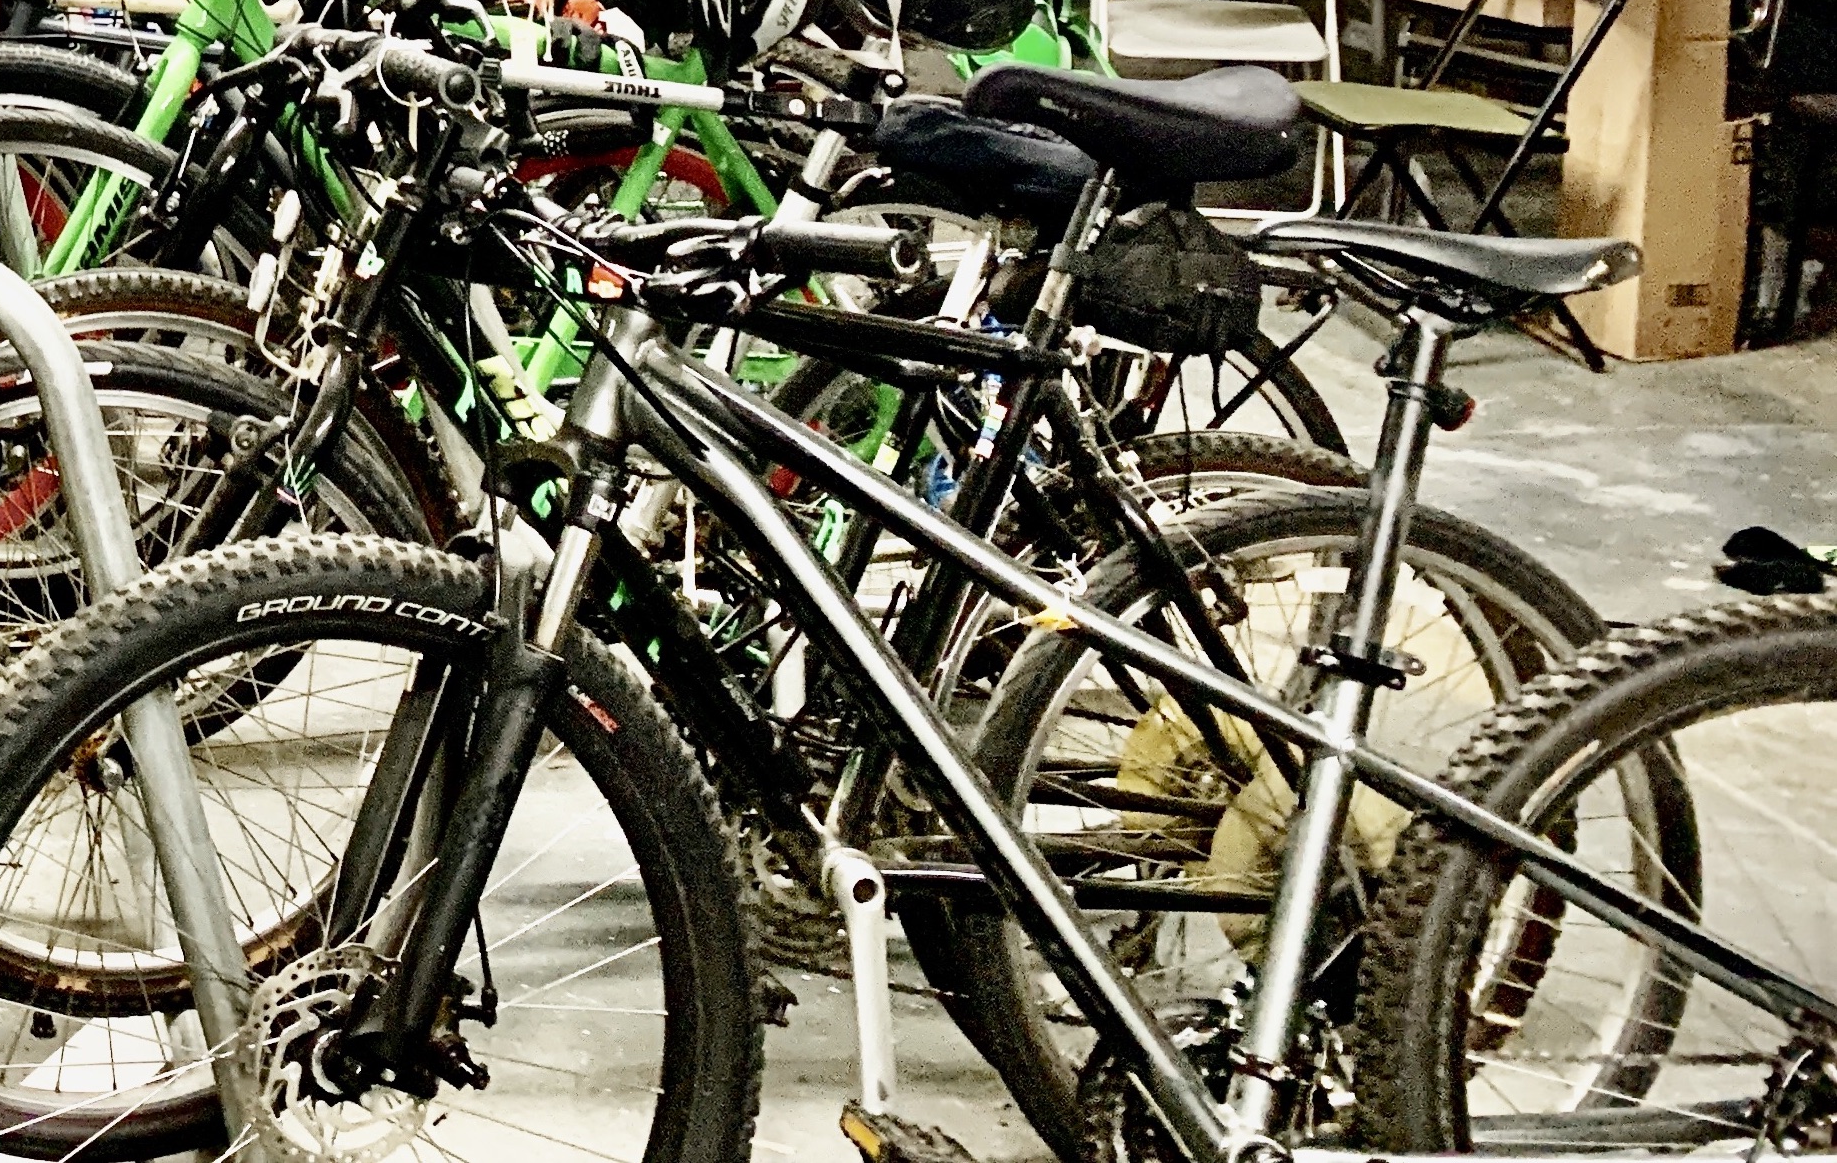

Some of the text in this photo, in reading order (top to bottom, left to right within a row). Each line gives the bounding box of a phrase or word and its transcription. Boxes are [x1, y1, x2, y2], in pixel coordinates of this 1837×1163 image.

[603, 80, 662, 99] THULE
[236, 593, 496, 638] GROUND CONT
